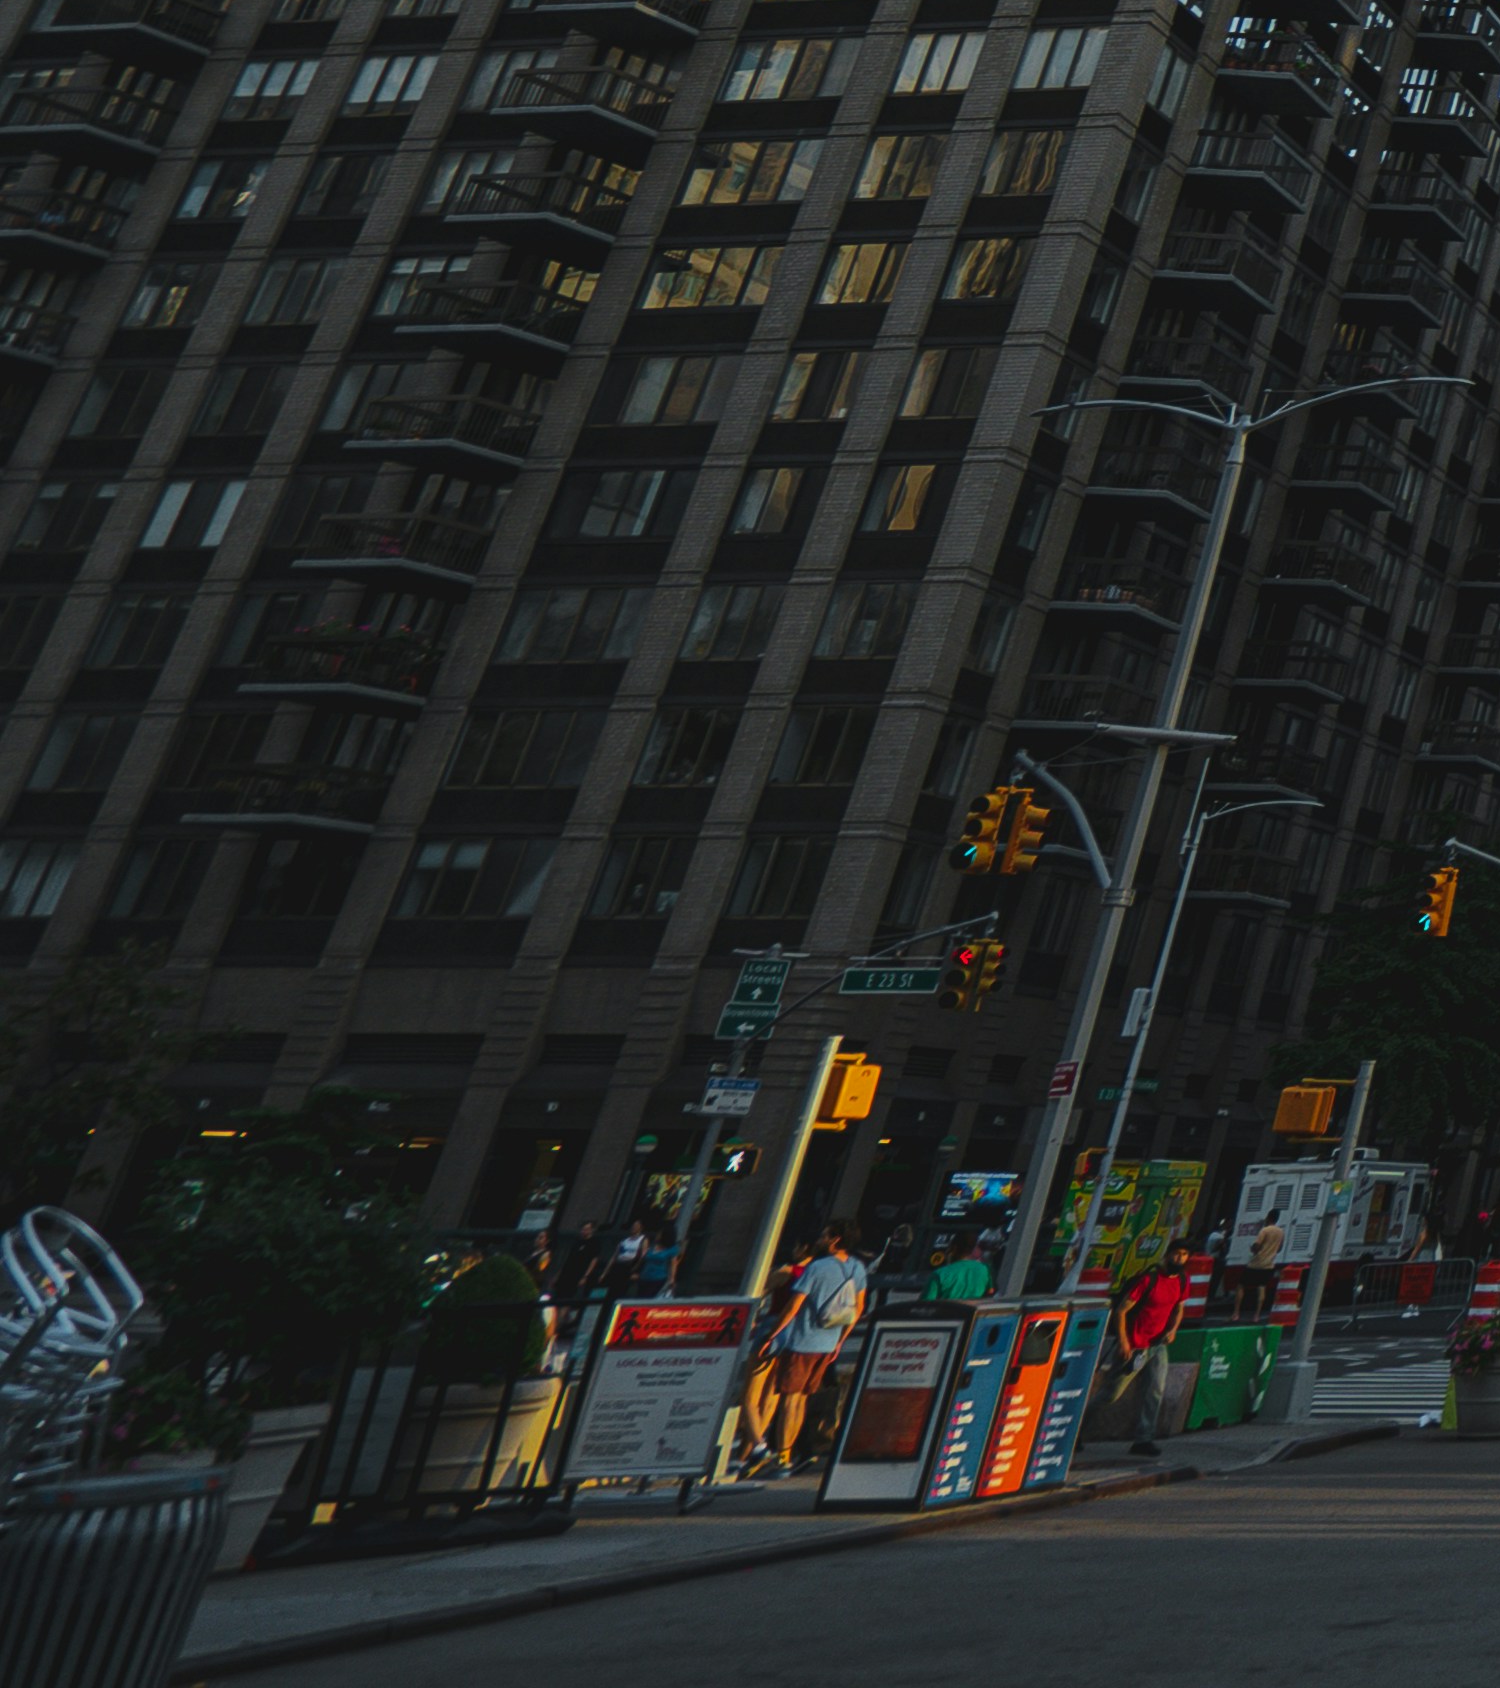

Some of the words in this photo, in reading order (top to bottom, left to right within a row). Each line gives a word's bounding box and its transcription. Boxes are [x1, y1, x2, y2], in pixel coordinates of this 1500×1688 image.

[747, 963, 783, 973] Local
[740, 974, 783, 984] Streets
[865, 973, 876, 988] E
[878, 973, 897, 988] 23
[898, 973, 914, 988] St
[885, 1338, 940, 1351] supporting
[616, 1357, 649, 1368] LOCAL
[694, 1355, 722, 1365] ONLY
[889, 1351, 929, 1360] cleaner
[877, 1363, 900, 1372] new
[900, 1362, 926, 1375] york
